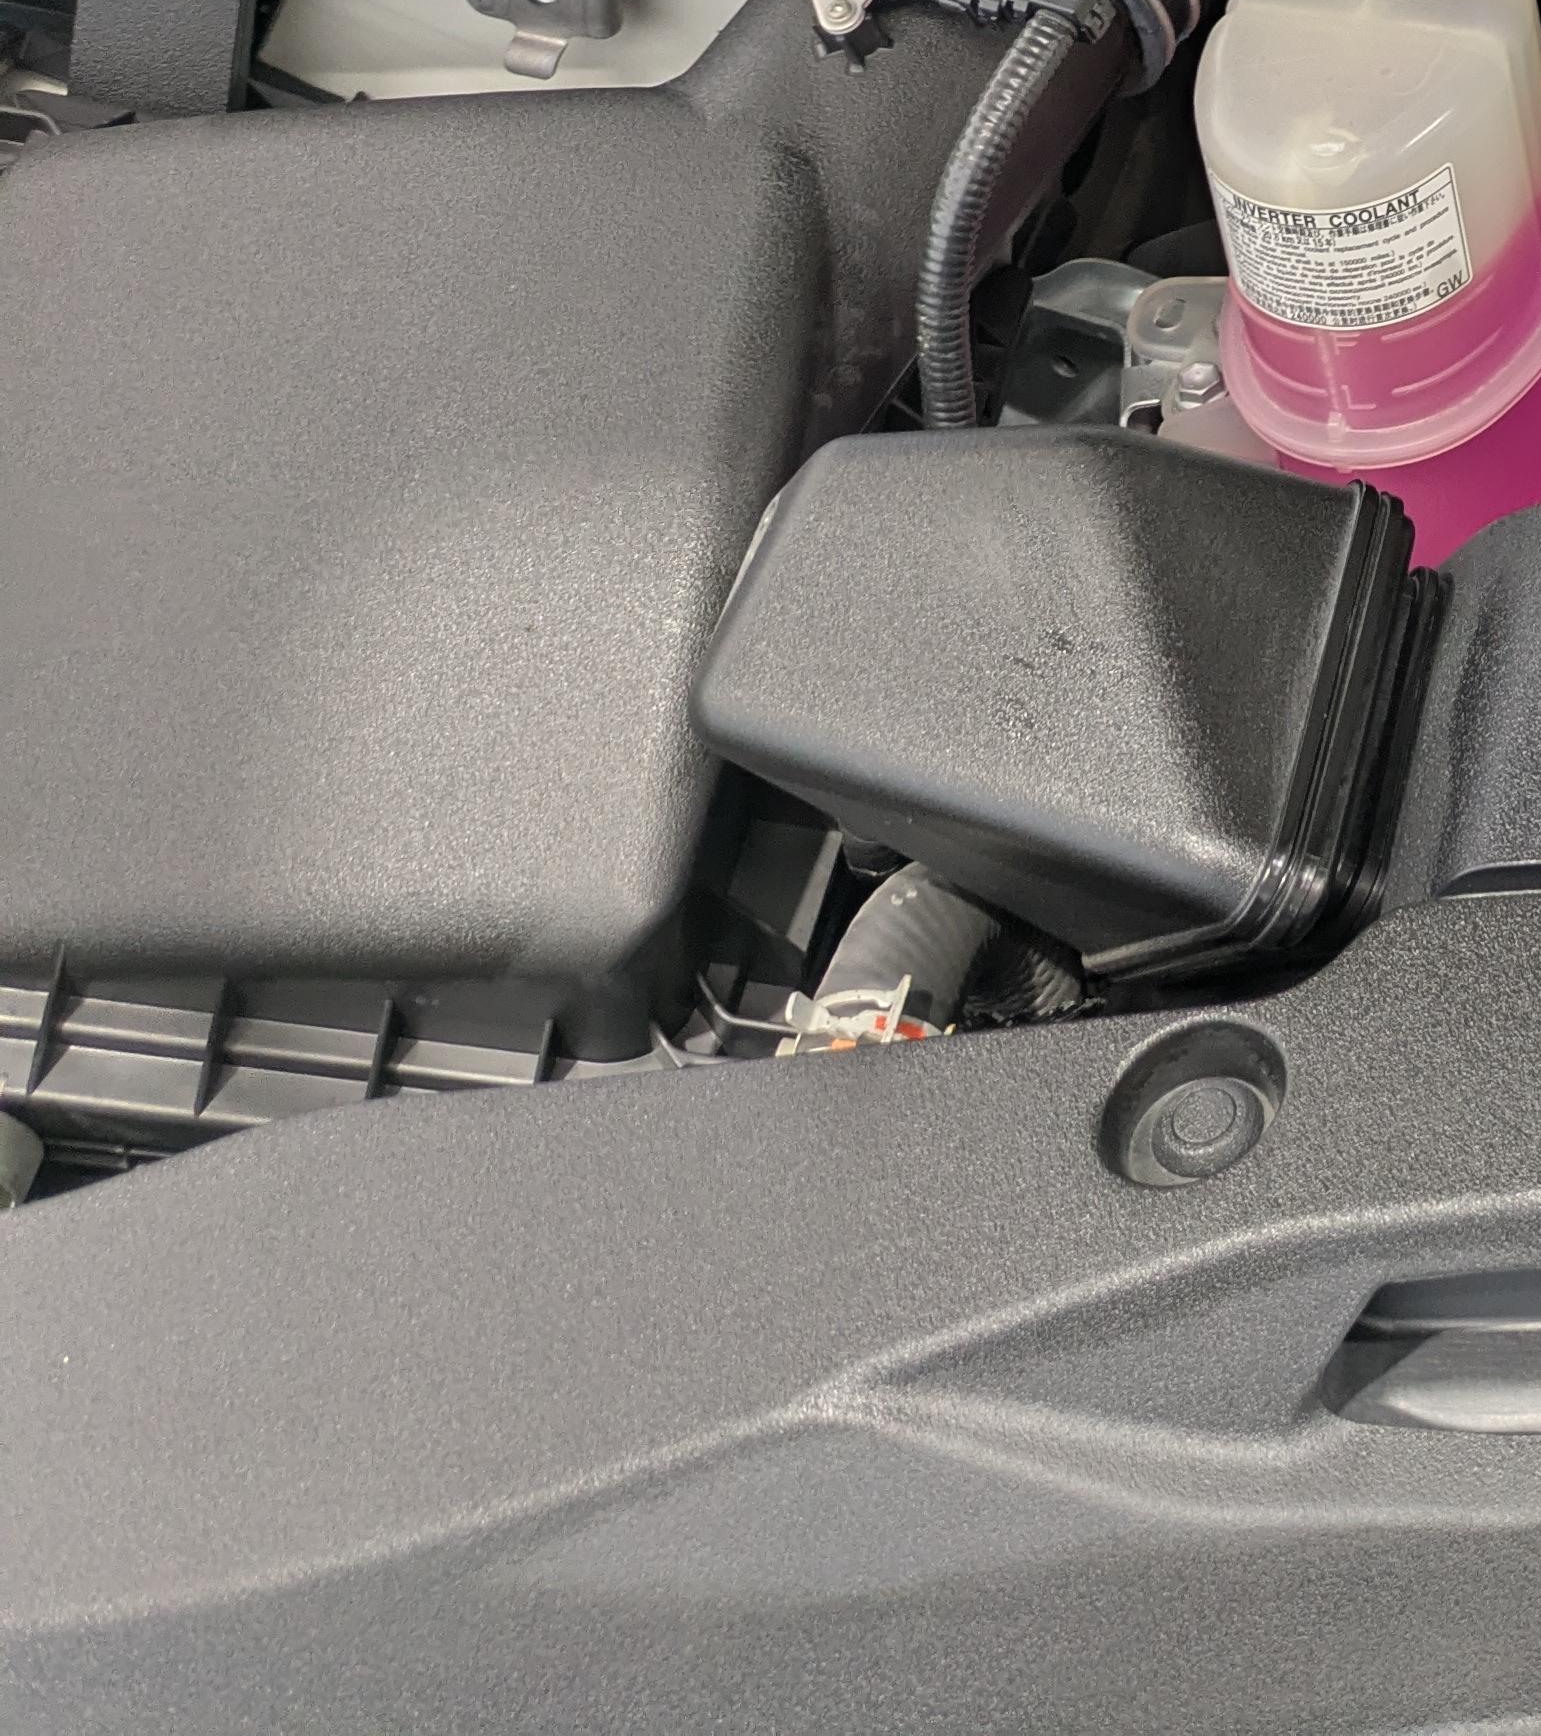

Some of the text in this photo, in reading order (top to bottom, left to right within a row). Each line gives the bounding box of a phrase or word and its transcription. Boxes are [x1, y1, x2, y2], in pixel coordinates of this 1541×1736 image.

[1232, 193, 1317, 228] INVERTER
[1329, 190, 1420, 228] COOLANT
[1437, 269, 1464, 300] GW
[1332, 332, 1361, 356] F
[1341, 384, 1377, 410] L
